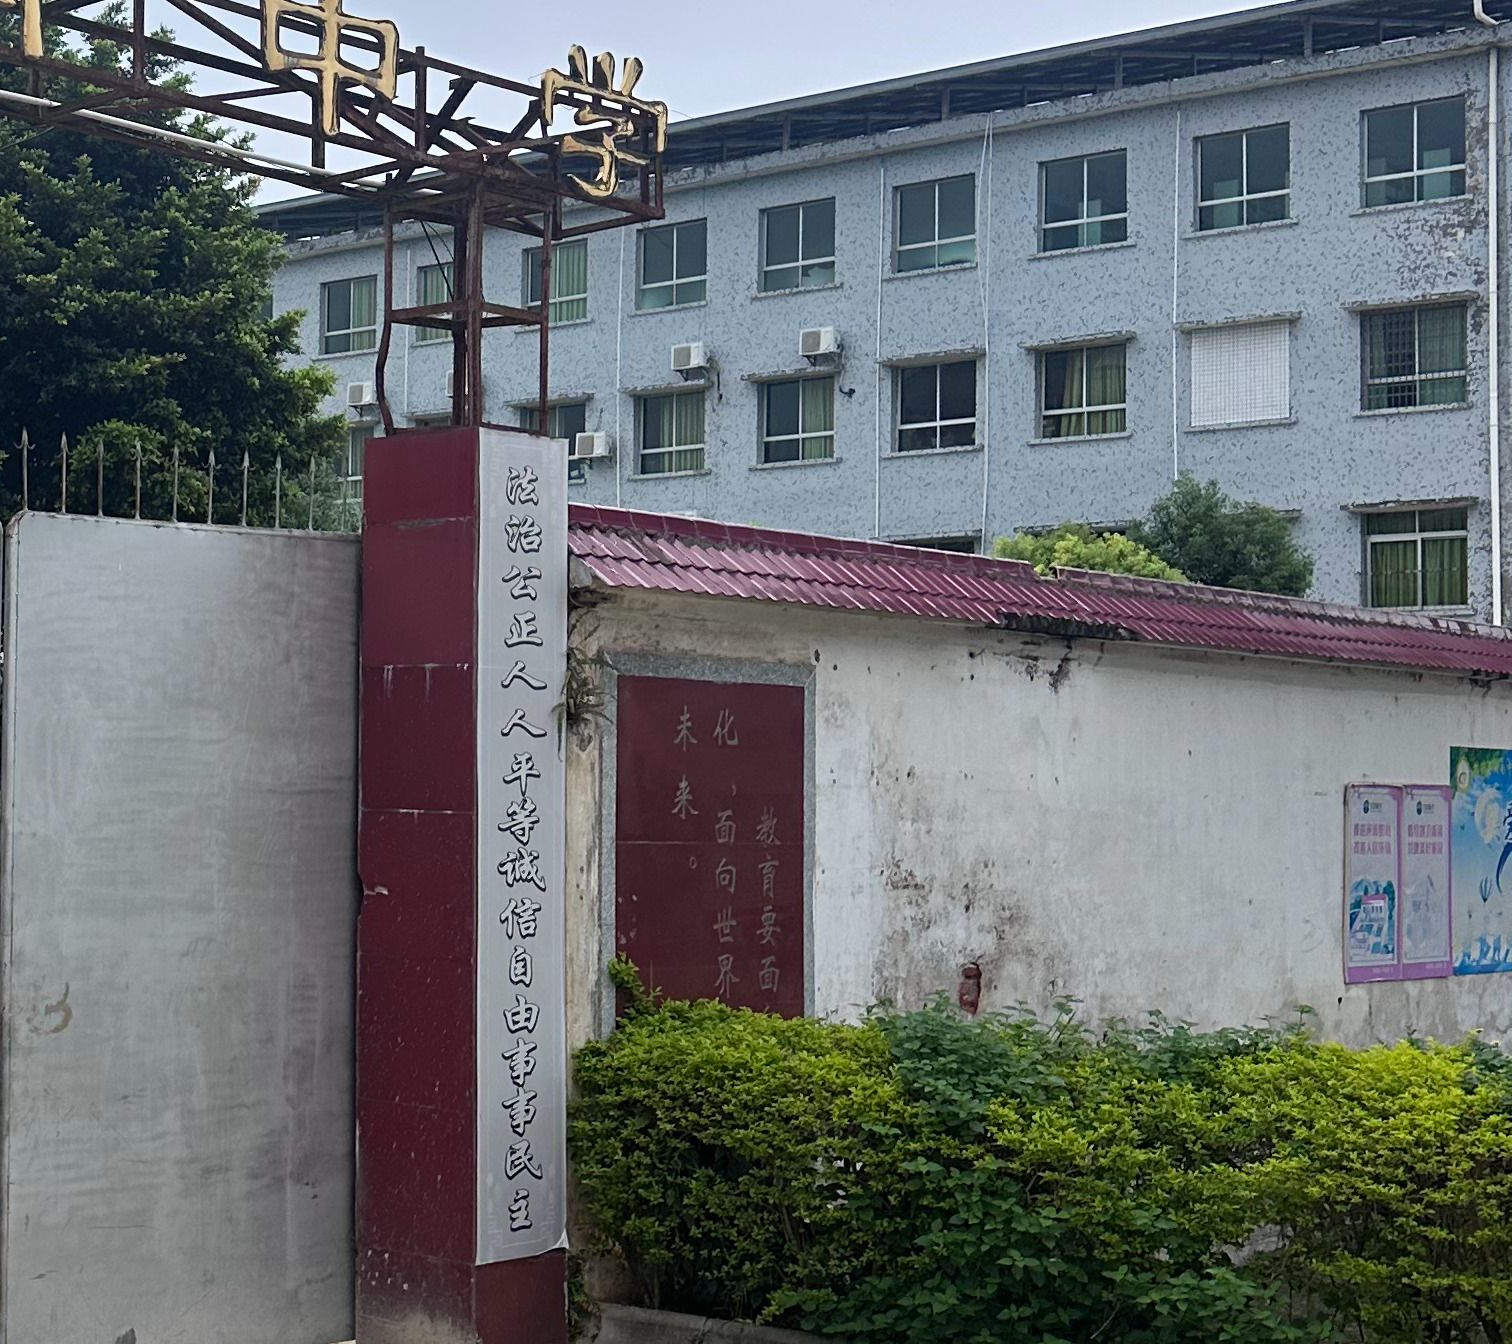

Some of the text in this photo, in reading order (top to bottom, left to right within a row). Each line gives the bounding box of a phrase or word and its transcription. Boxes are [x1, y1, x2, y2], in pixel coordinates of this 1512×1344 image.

[497, 465, 548, 1233] 法治公正人人平等诚信自由事事民主
[755, 806, 781, 1013] 教育要面
